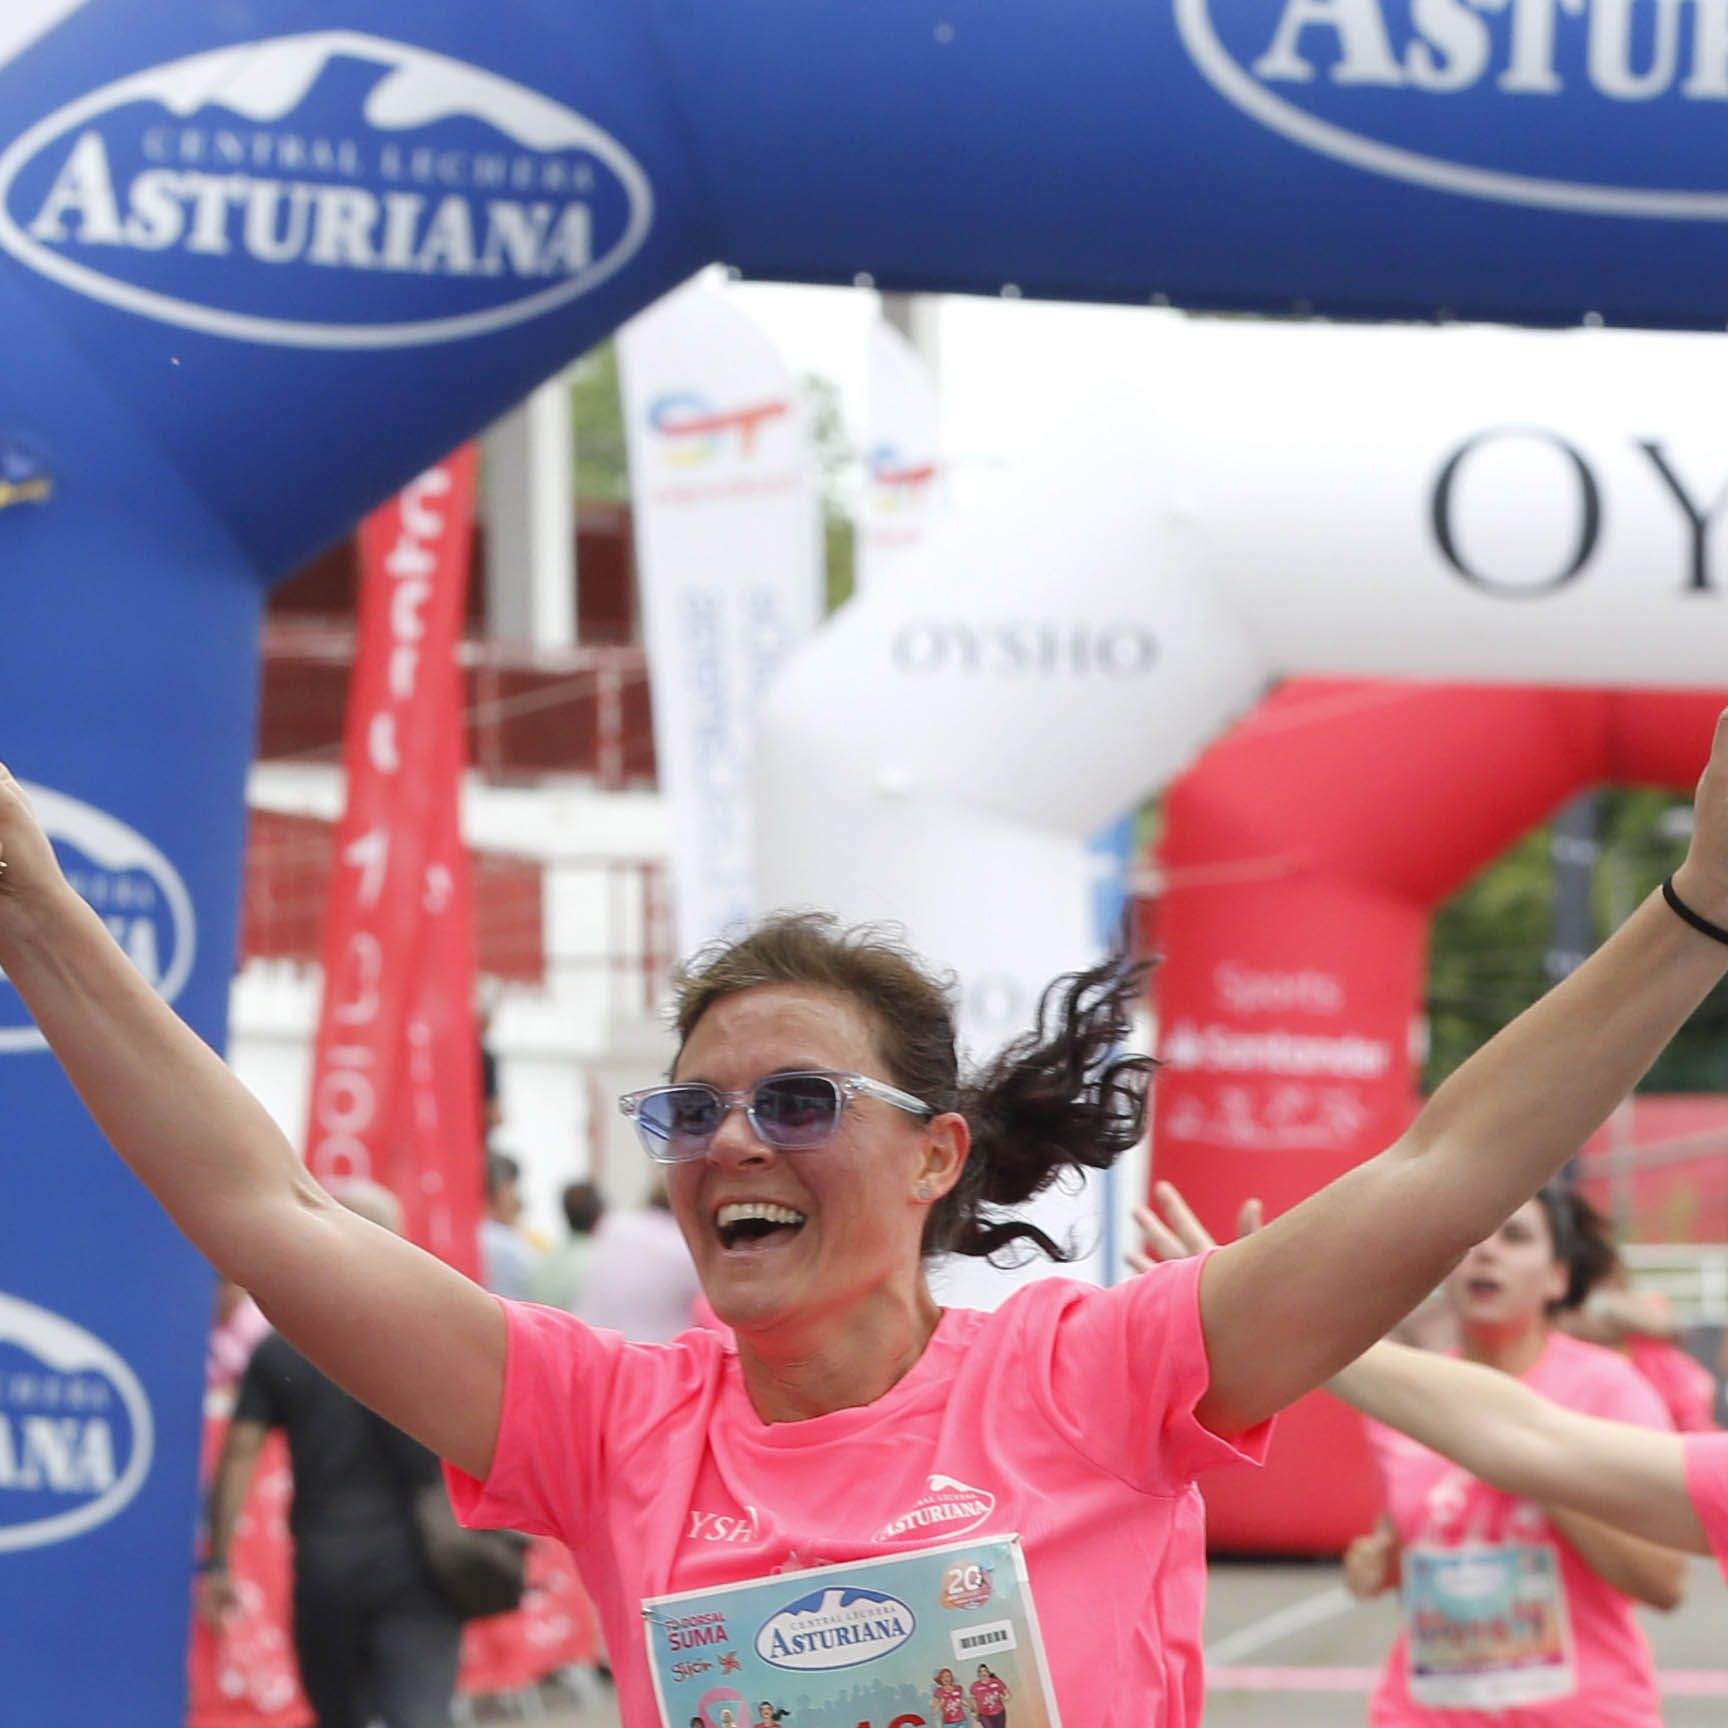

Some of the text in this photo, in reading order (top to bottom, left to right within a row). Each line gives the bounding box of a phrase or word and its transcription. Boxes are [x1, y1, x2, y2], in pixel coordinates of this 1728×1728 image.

[30, 132, 593, 276] ASTURIANA
[889, 617, 1161, 681] OYSHO
[668, 1625, 729, 1652] SUMA
[770, 1616, 908, 1660] ASTURIANA
